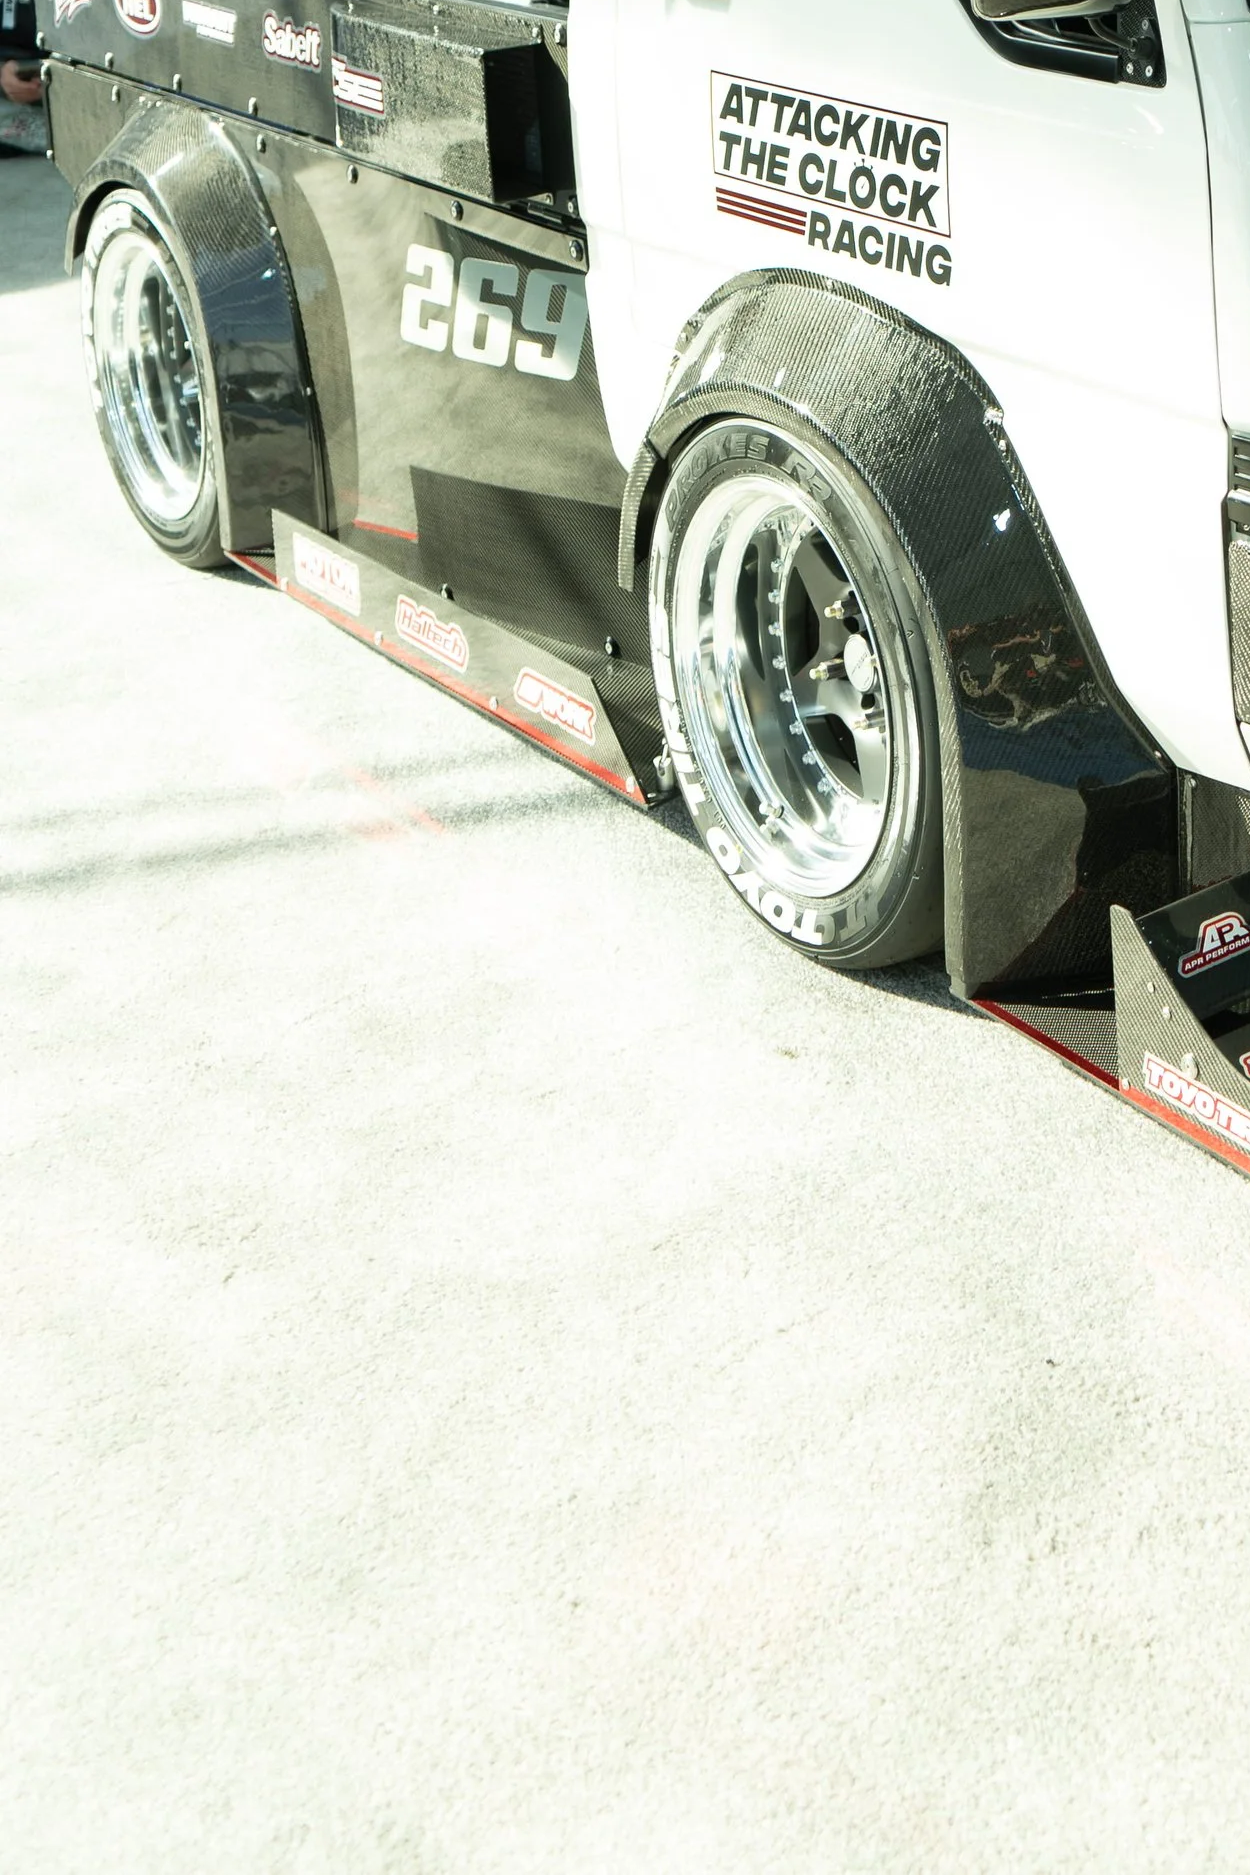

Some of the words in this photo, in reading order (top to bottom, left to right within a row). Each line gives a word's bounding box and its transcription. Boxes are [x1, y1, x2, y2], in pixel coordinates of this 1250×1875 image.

[264, 15, 321, 67] Sabelt
[718, 83, 943, 173] ATTACKING
[718, 132, 791, 186] THE
[798, 152, 938, 228] CLOCK
[808, 211, 952, 287] RACING
[400, 243, 589, 382] 269
[402, 606, 463, 658] Haltech
[706, 826, 823, 946] TOYO
[1184, 955, 1205, 972] APR
[1147, 1059, 1216, 1119] TOYO
